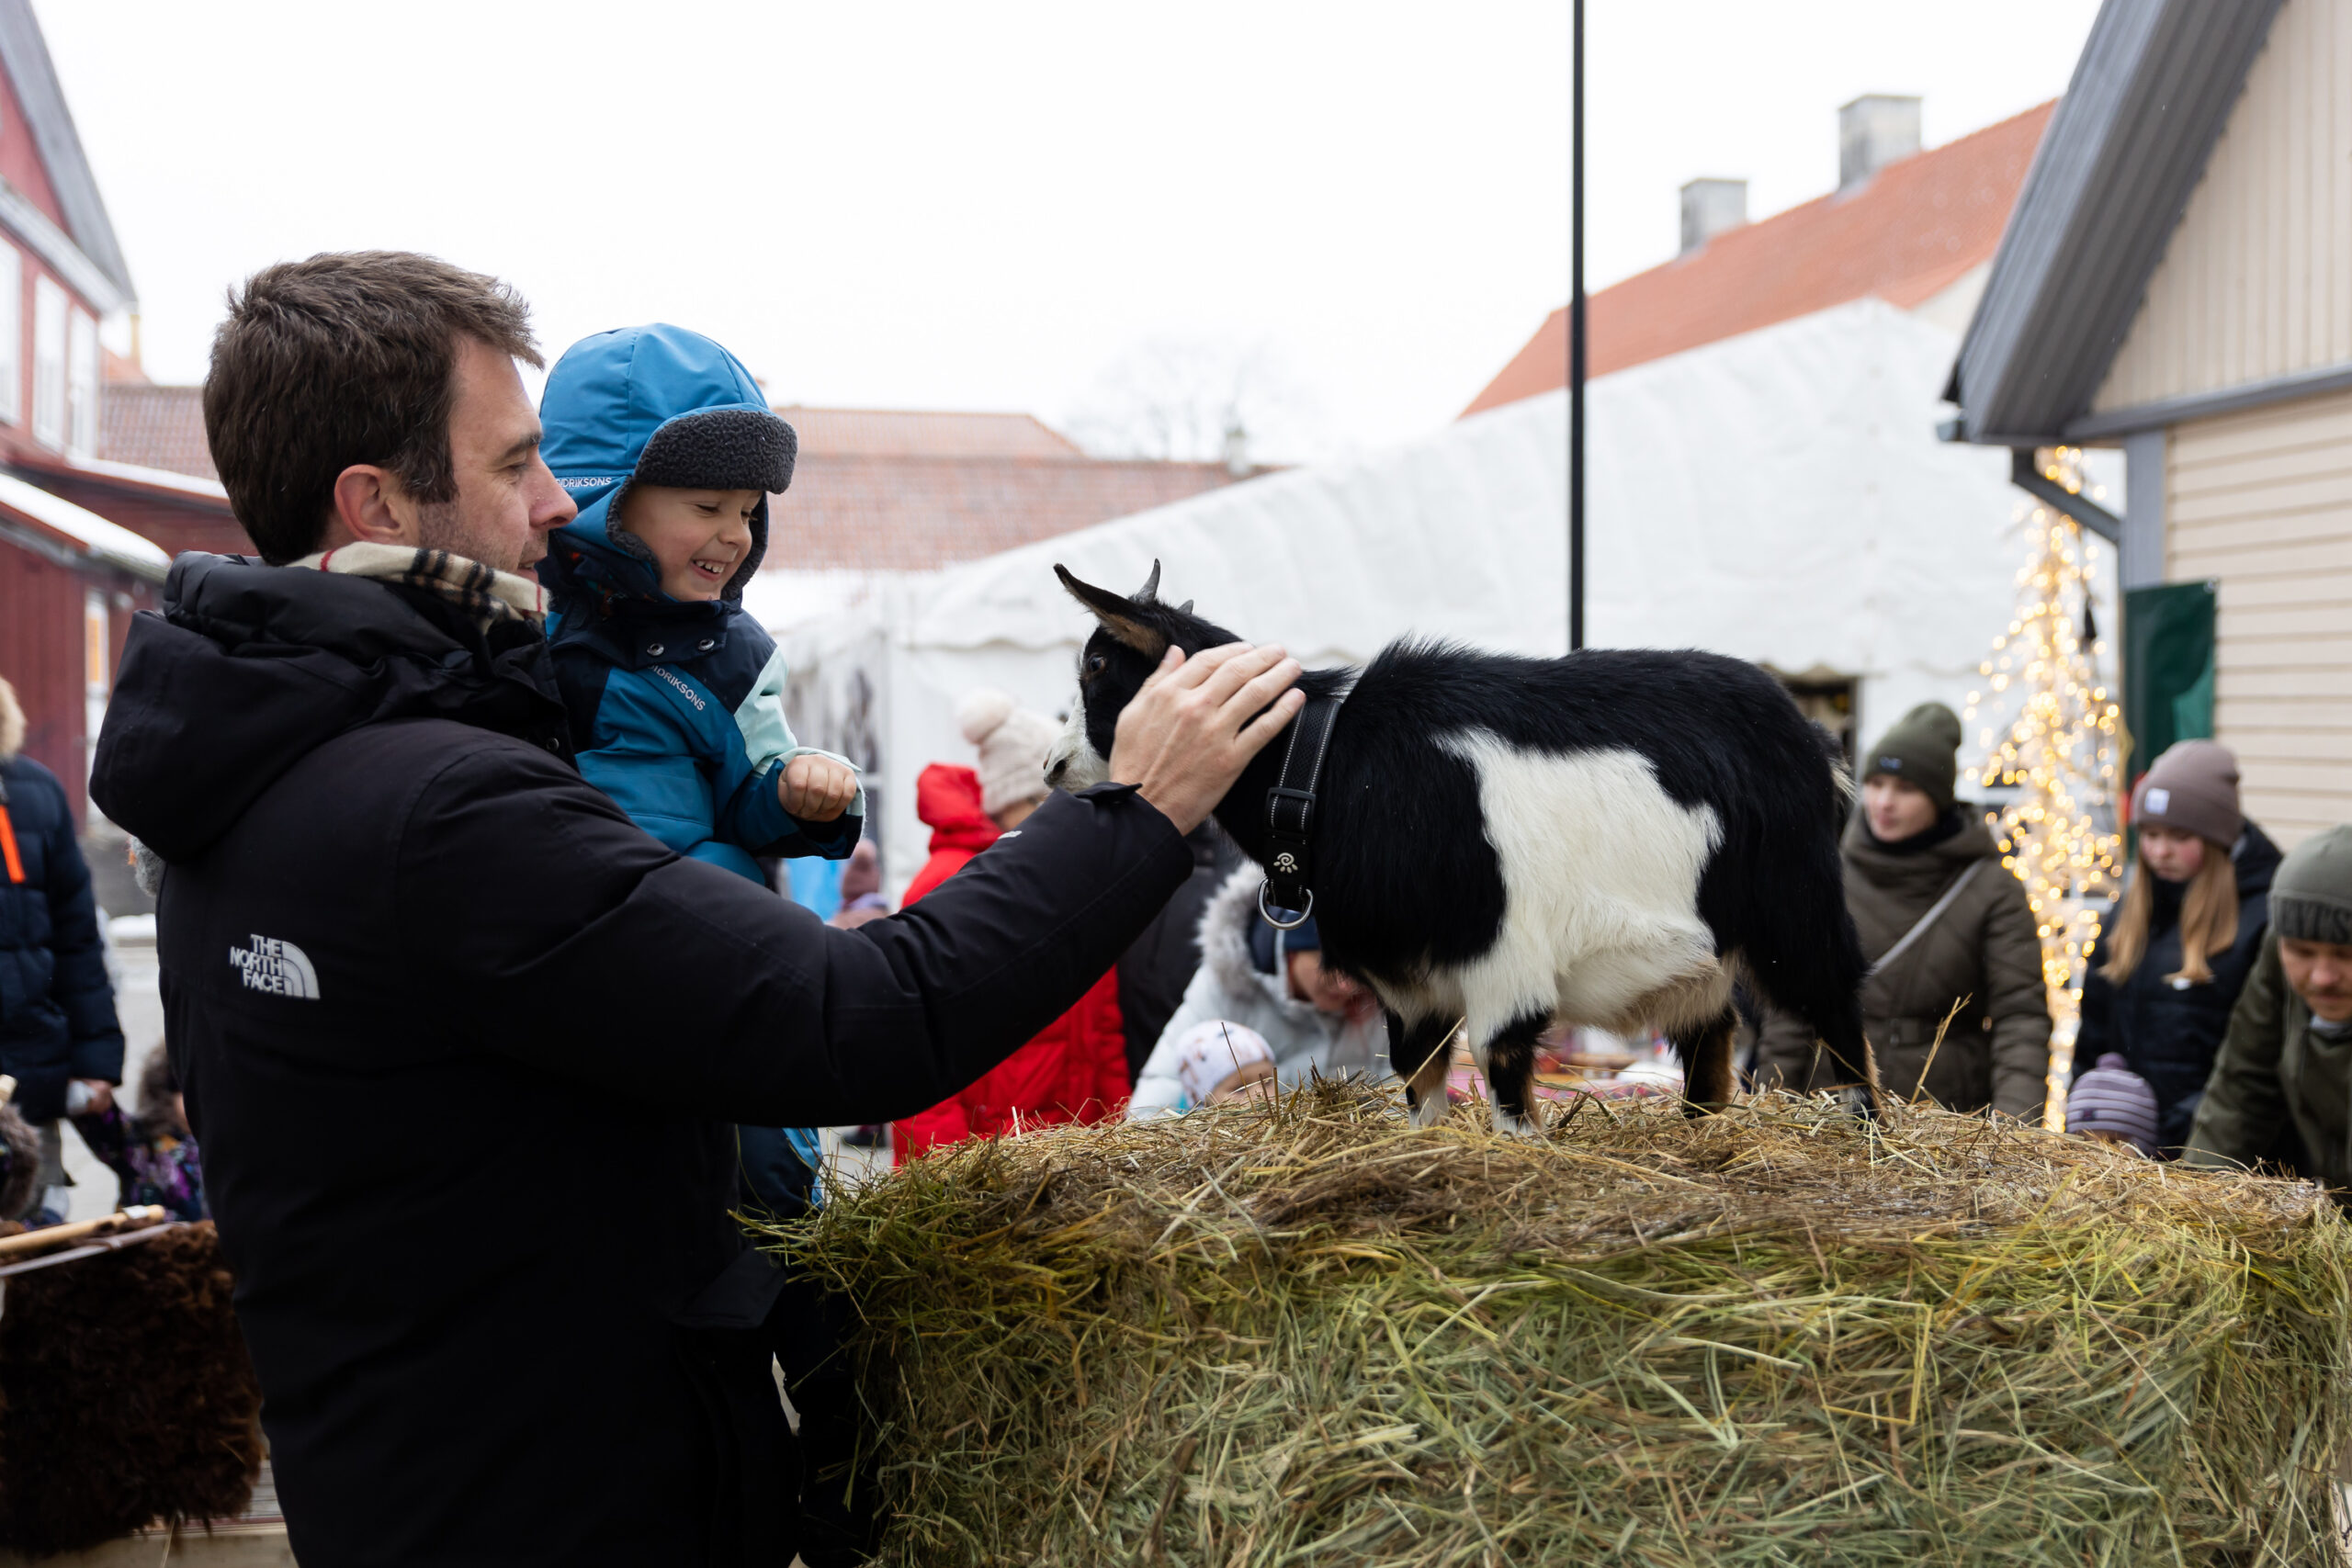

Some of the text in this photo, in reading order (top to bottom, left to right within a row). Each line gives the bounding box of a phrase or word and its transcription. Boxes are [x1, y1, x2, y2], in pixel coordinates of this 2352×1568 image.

[250, 933, 283, 957] THE
[230, 946, 284, 976] NORTH
[243, 967, 285, 995] FACE
